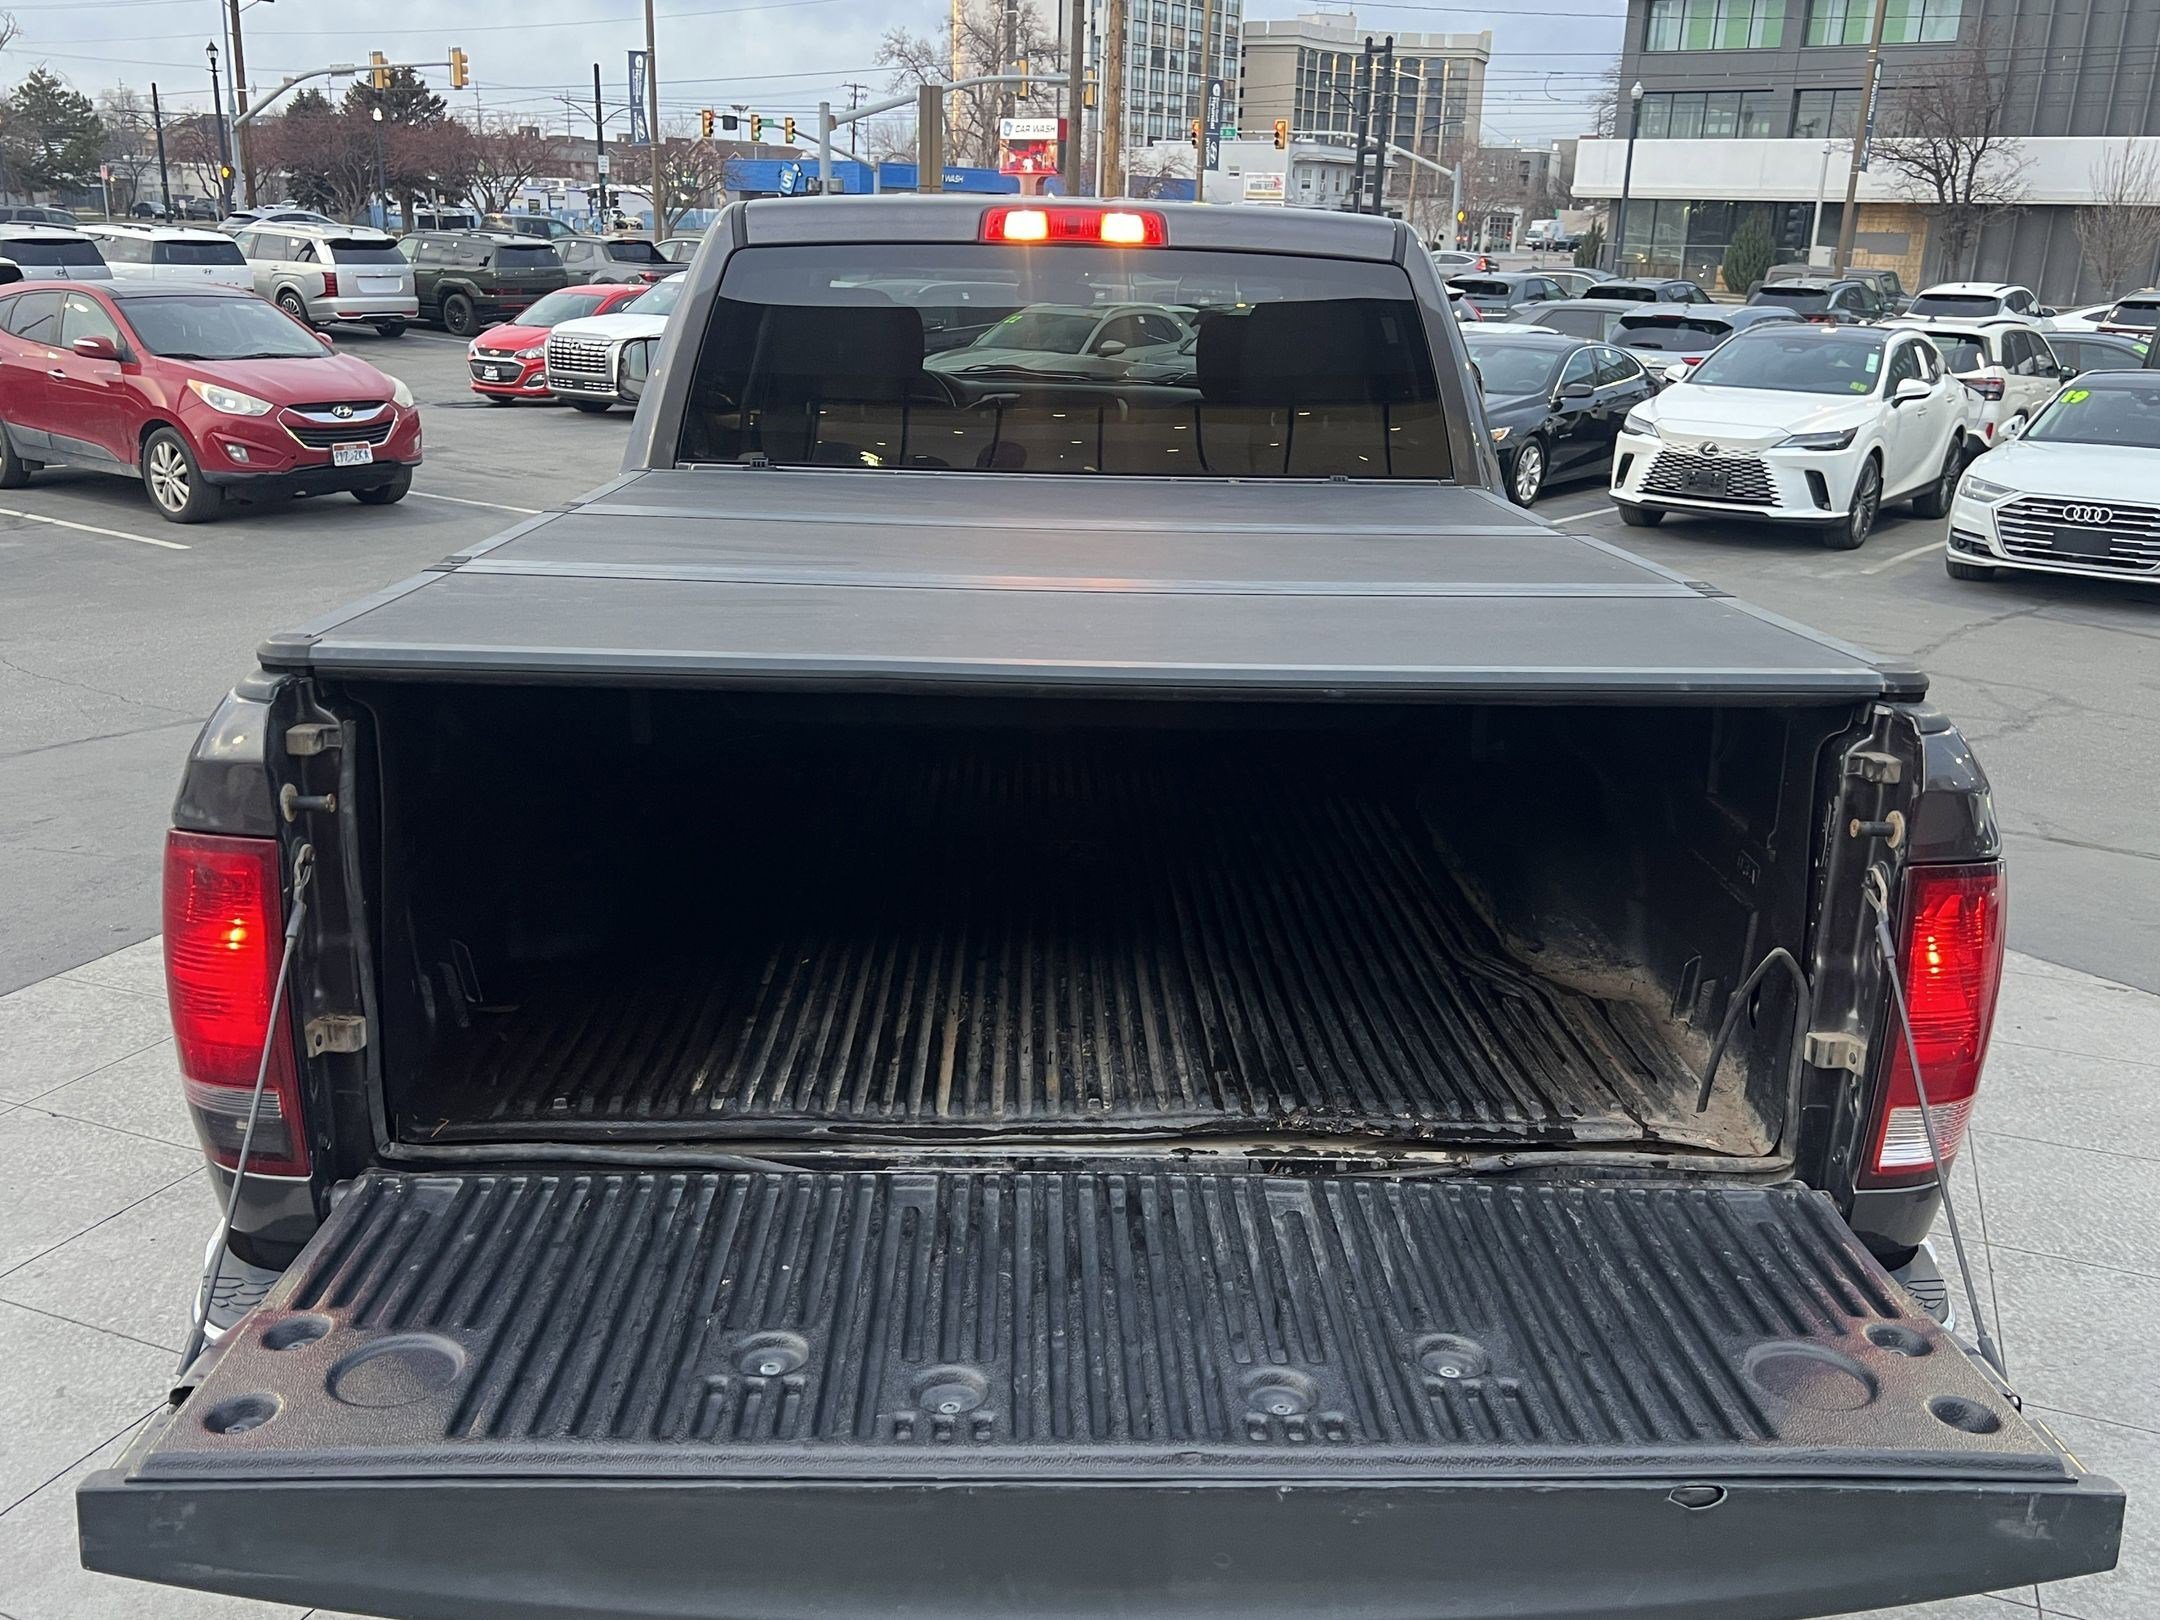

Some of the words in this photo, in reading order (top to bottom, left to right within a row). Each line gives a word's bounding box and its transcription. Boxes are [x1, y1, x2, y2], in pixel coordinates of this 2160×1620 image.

[1015, 124, 1031, 133] CAR
[1033, 124, 1056, 133] WASH
[945, 174, 964, 183] WASH
[2060, 390, 2089, 404] 19
